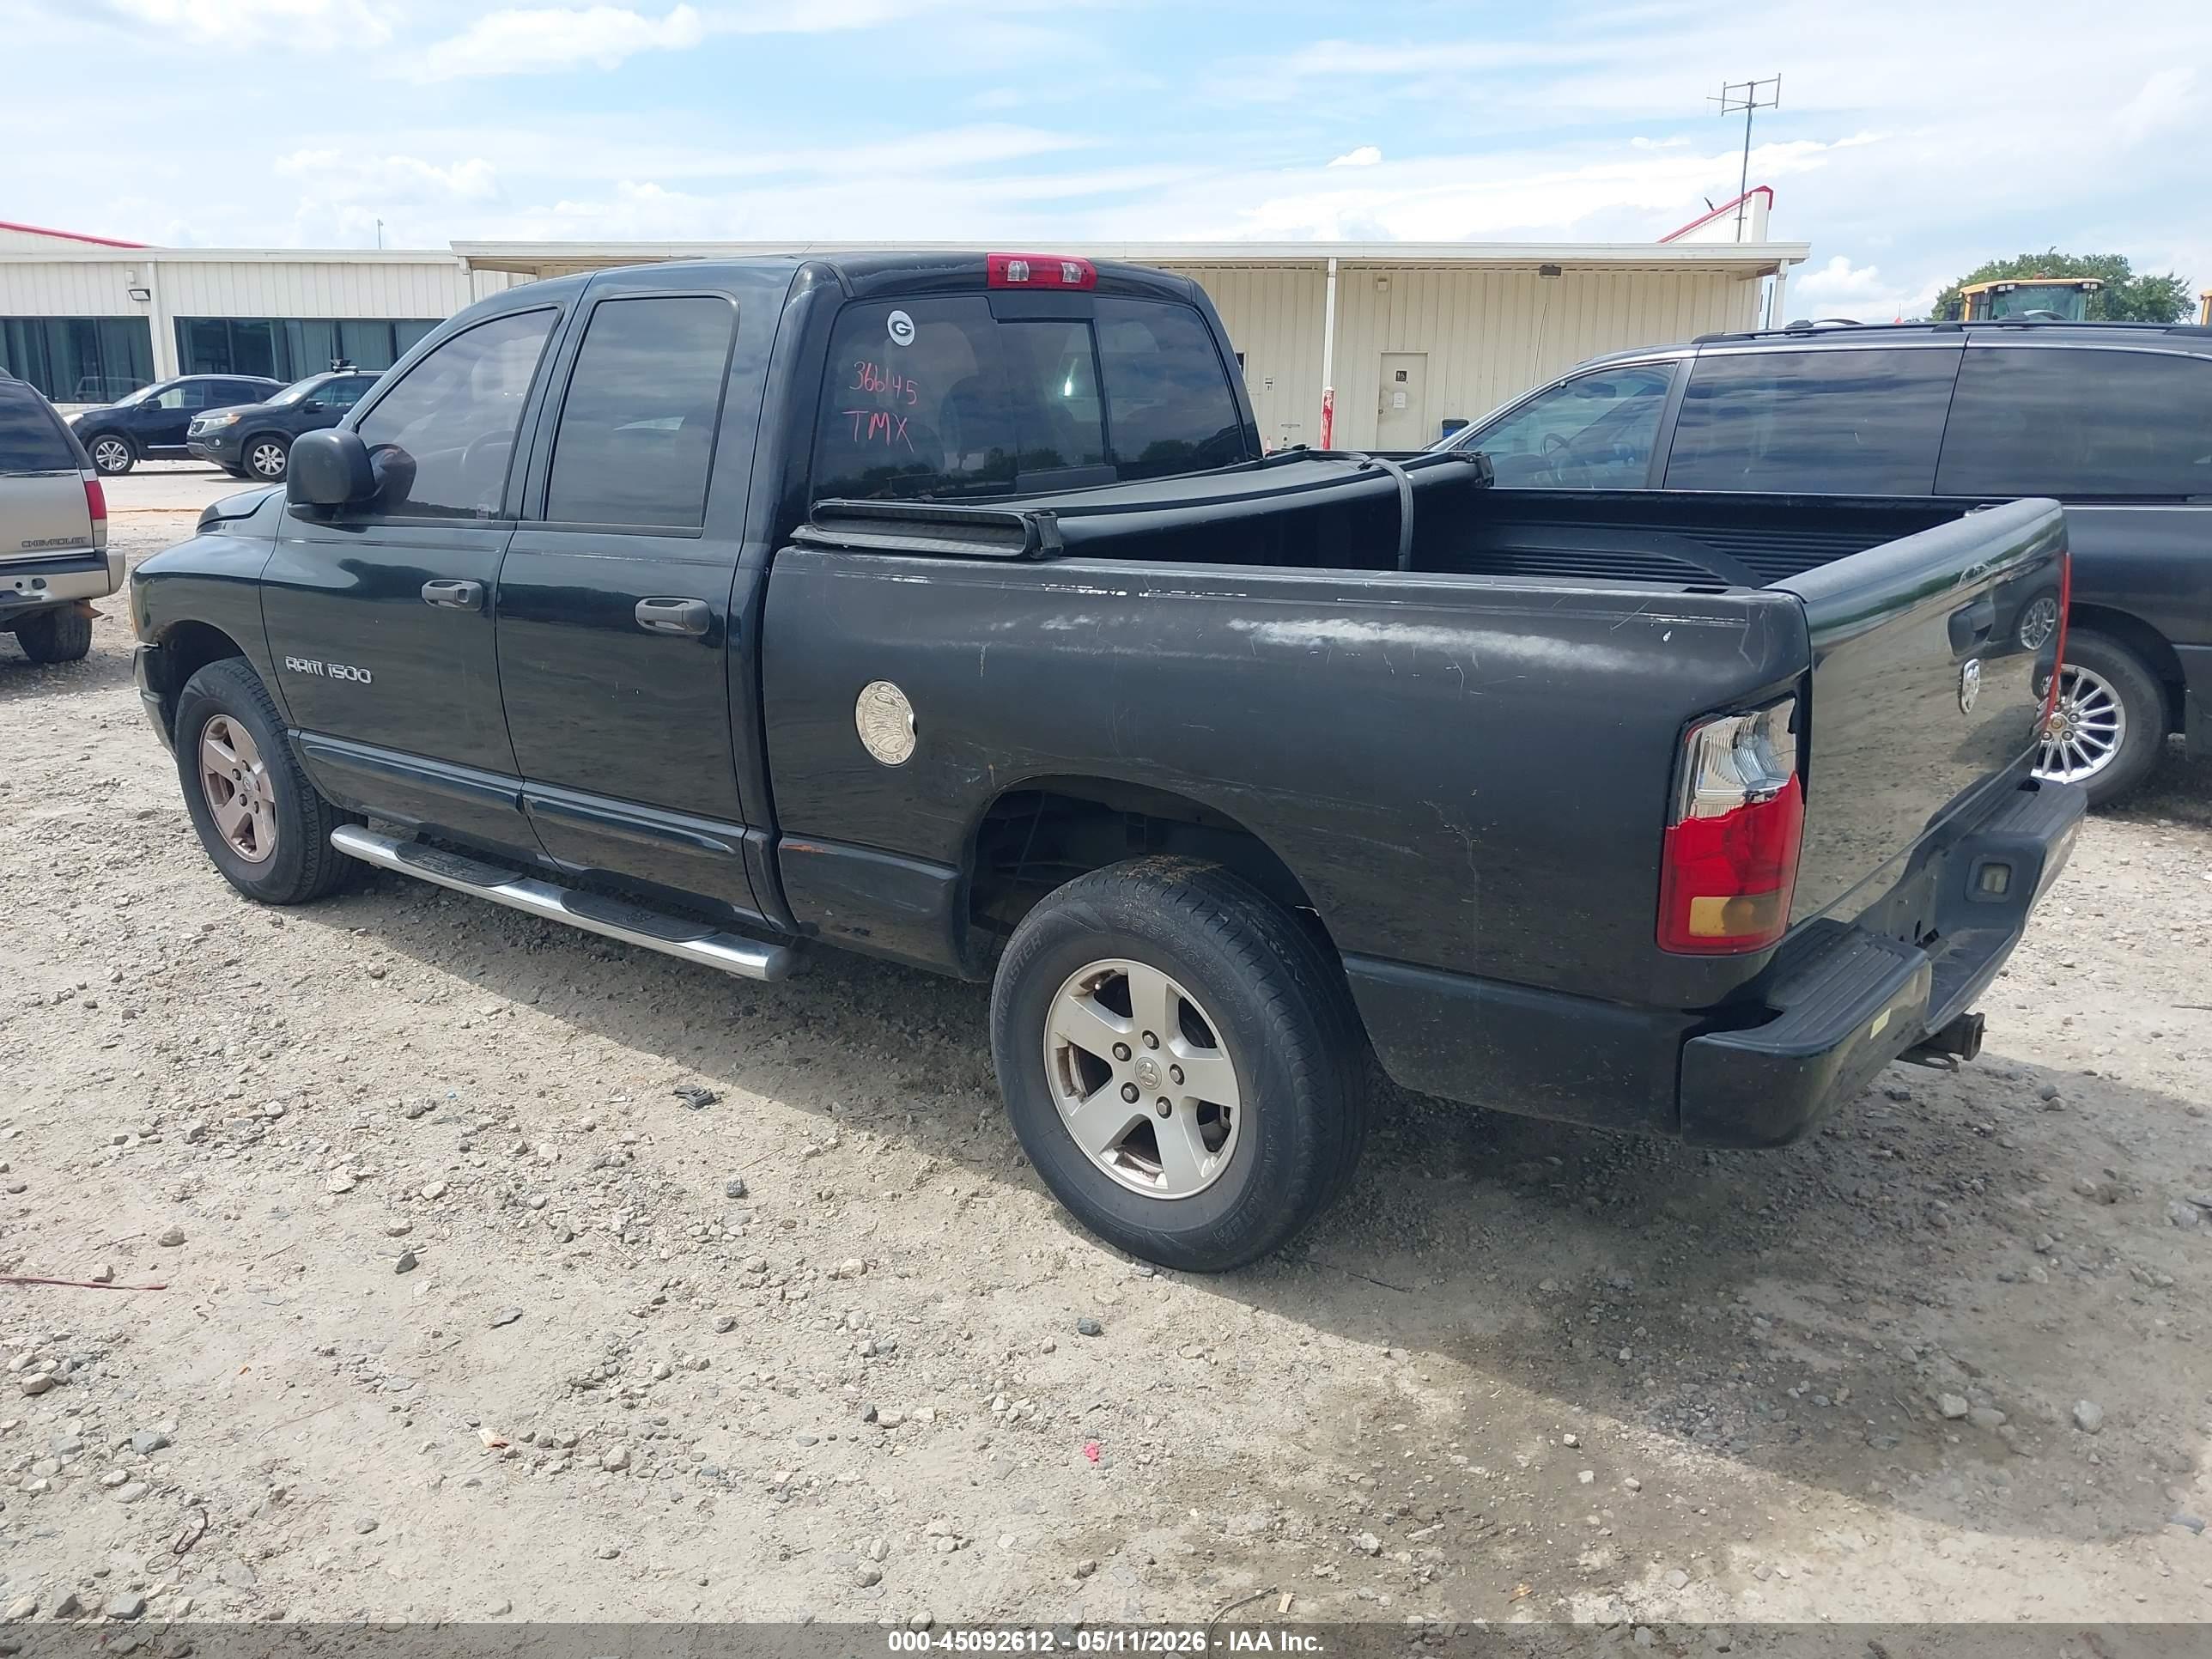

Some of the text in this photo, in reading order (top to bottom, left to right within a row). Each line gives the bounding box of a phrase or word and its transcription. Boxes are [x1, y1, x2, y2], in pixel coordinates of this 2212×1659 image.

[891, 320, 911, 337] G
[848, 361, 919, 405] 366145
[842, 410, 915, 453] TMX
[21, 537, 87, 548] CHEVROLET
[284, 655, 373, 684] RAM 1500
